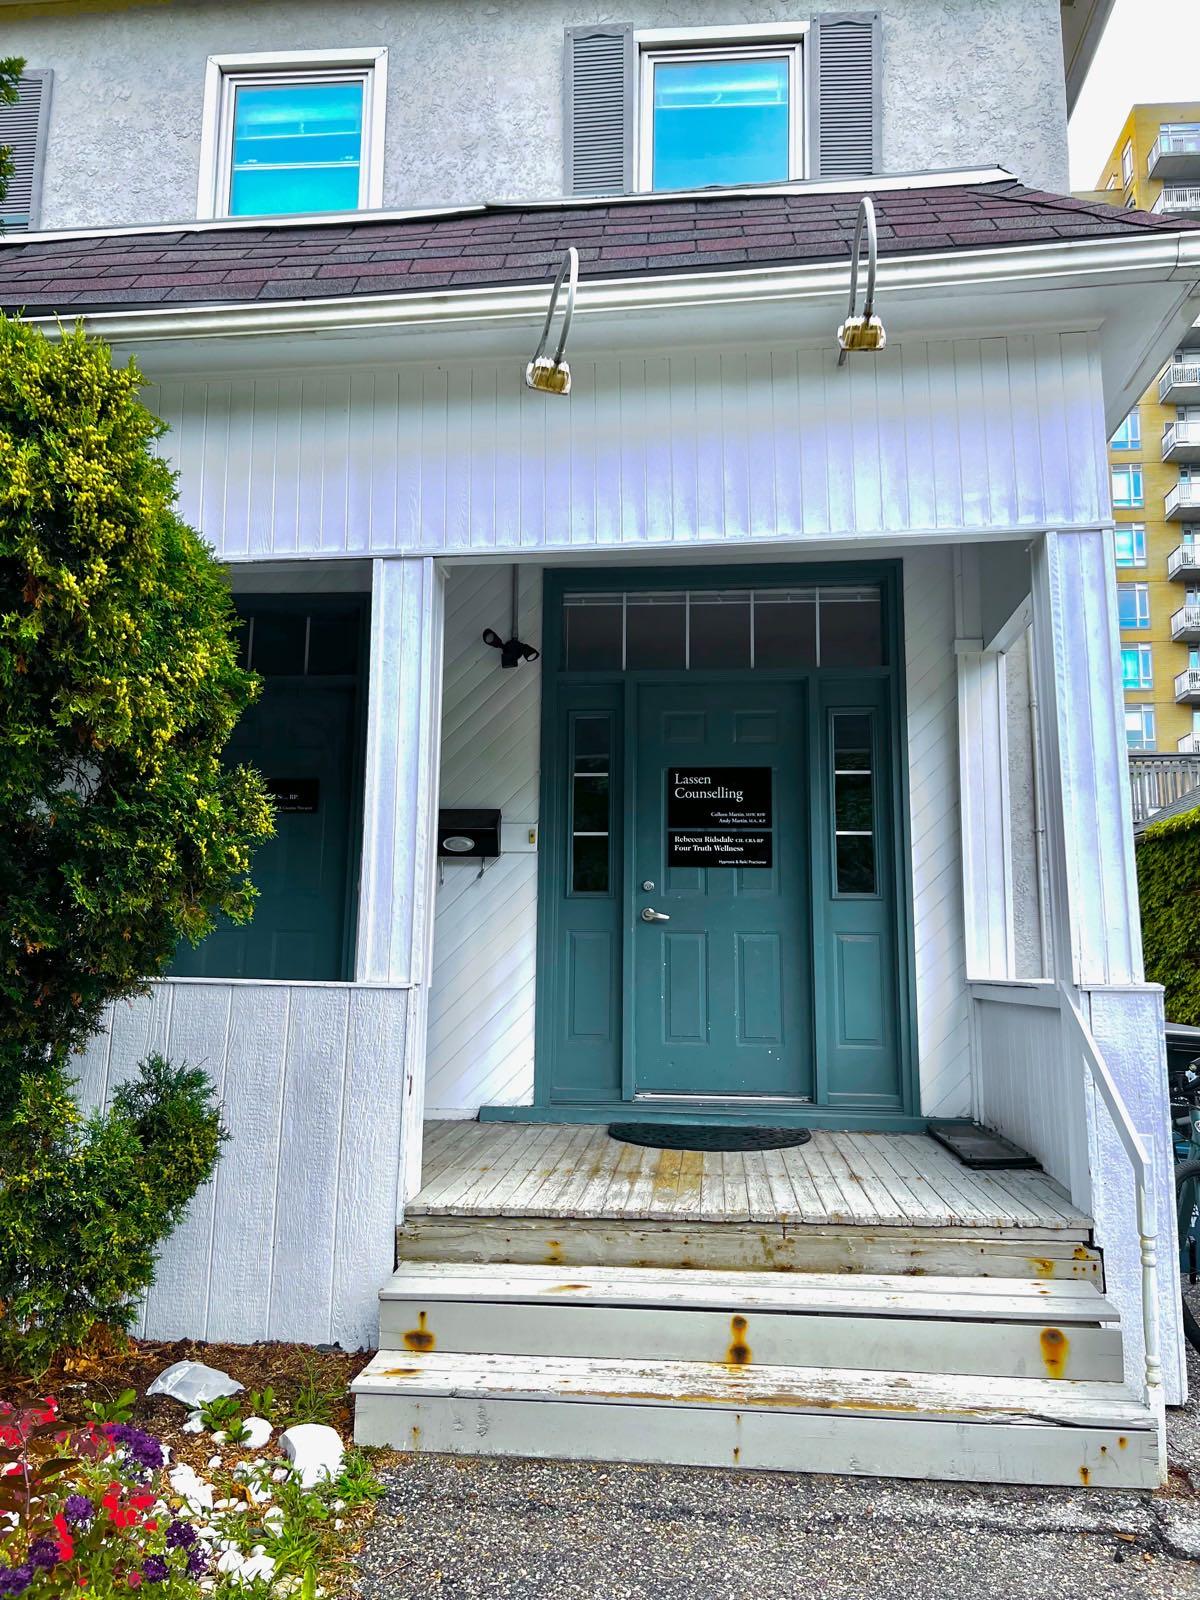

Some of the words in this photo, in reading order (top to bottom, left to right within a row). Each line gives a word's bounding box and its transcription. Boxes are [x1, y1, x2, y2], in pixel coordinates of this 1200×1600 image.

[675, 773, 711, 785] Lassen
[675, 787, 743, 802] Counselling
[674, 835, 703, 843] Rebecca
[704, 835, 734, 843] Ridsdale
